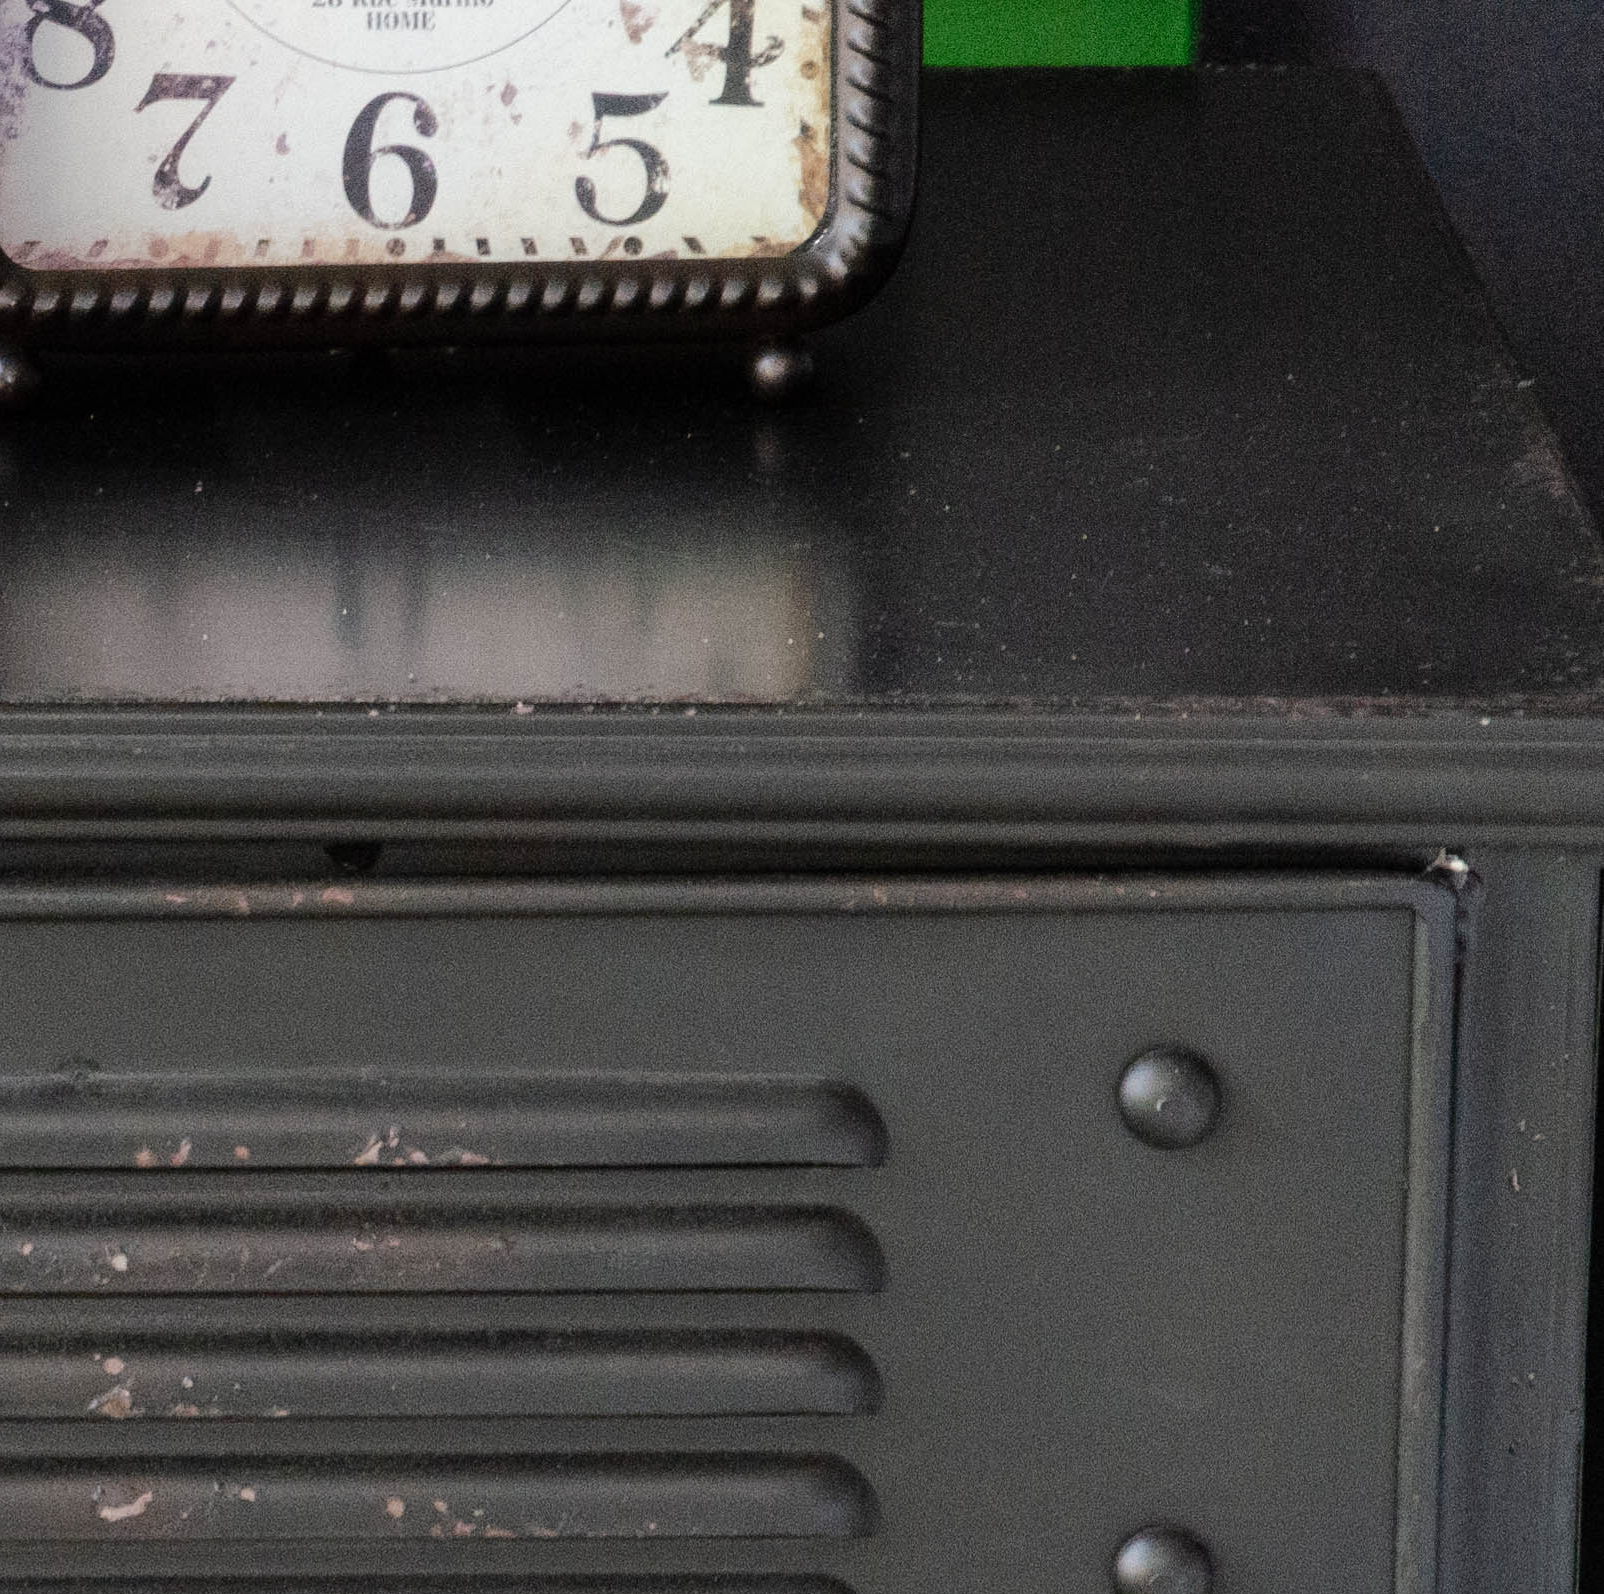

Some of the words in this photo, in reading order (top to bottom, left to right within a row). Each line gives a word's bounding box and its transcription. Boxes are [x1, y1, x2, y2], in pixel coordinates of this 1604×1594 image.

[20, 0, 116, 90] 8
[367, 11, 436, 31] HOME
[665, 0, 785, 107] 4
[133, 73, 236, 211] 7
[343, 91, 439, 231] 6
[575, 91, 669, 227] 5
